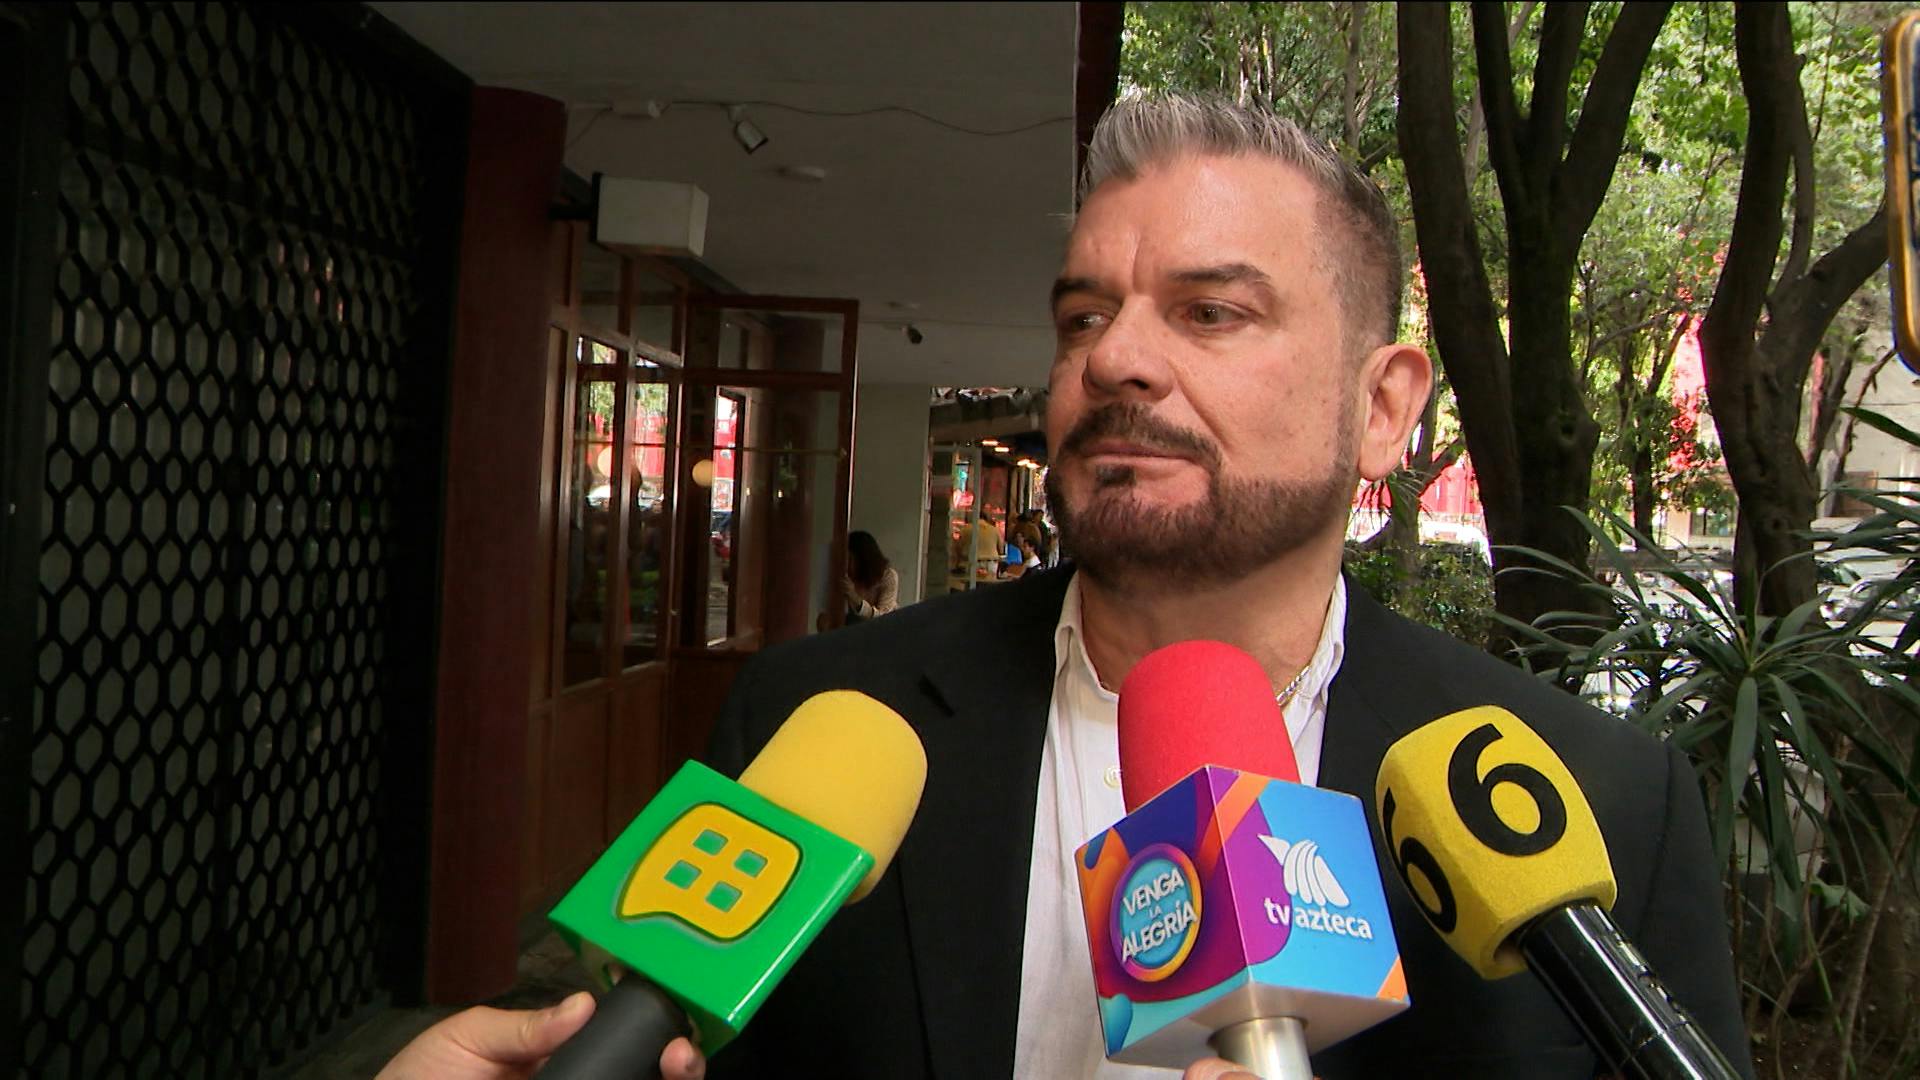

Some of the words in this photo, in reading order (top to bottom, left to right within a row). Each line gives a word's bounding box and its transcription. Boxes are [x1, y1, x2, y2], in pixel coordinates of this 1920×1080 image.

[1448, 723, 1567, 857] 6
[1123, 867, 1185, 916] VENGA
[1149, 905, 1163, 919] LA
[1122, 900, 1198, 963] ALEGRÍA
[1263, 897, 1291, 926] tv
[1294, 906, 1374, 940] azteca
